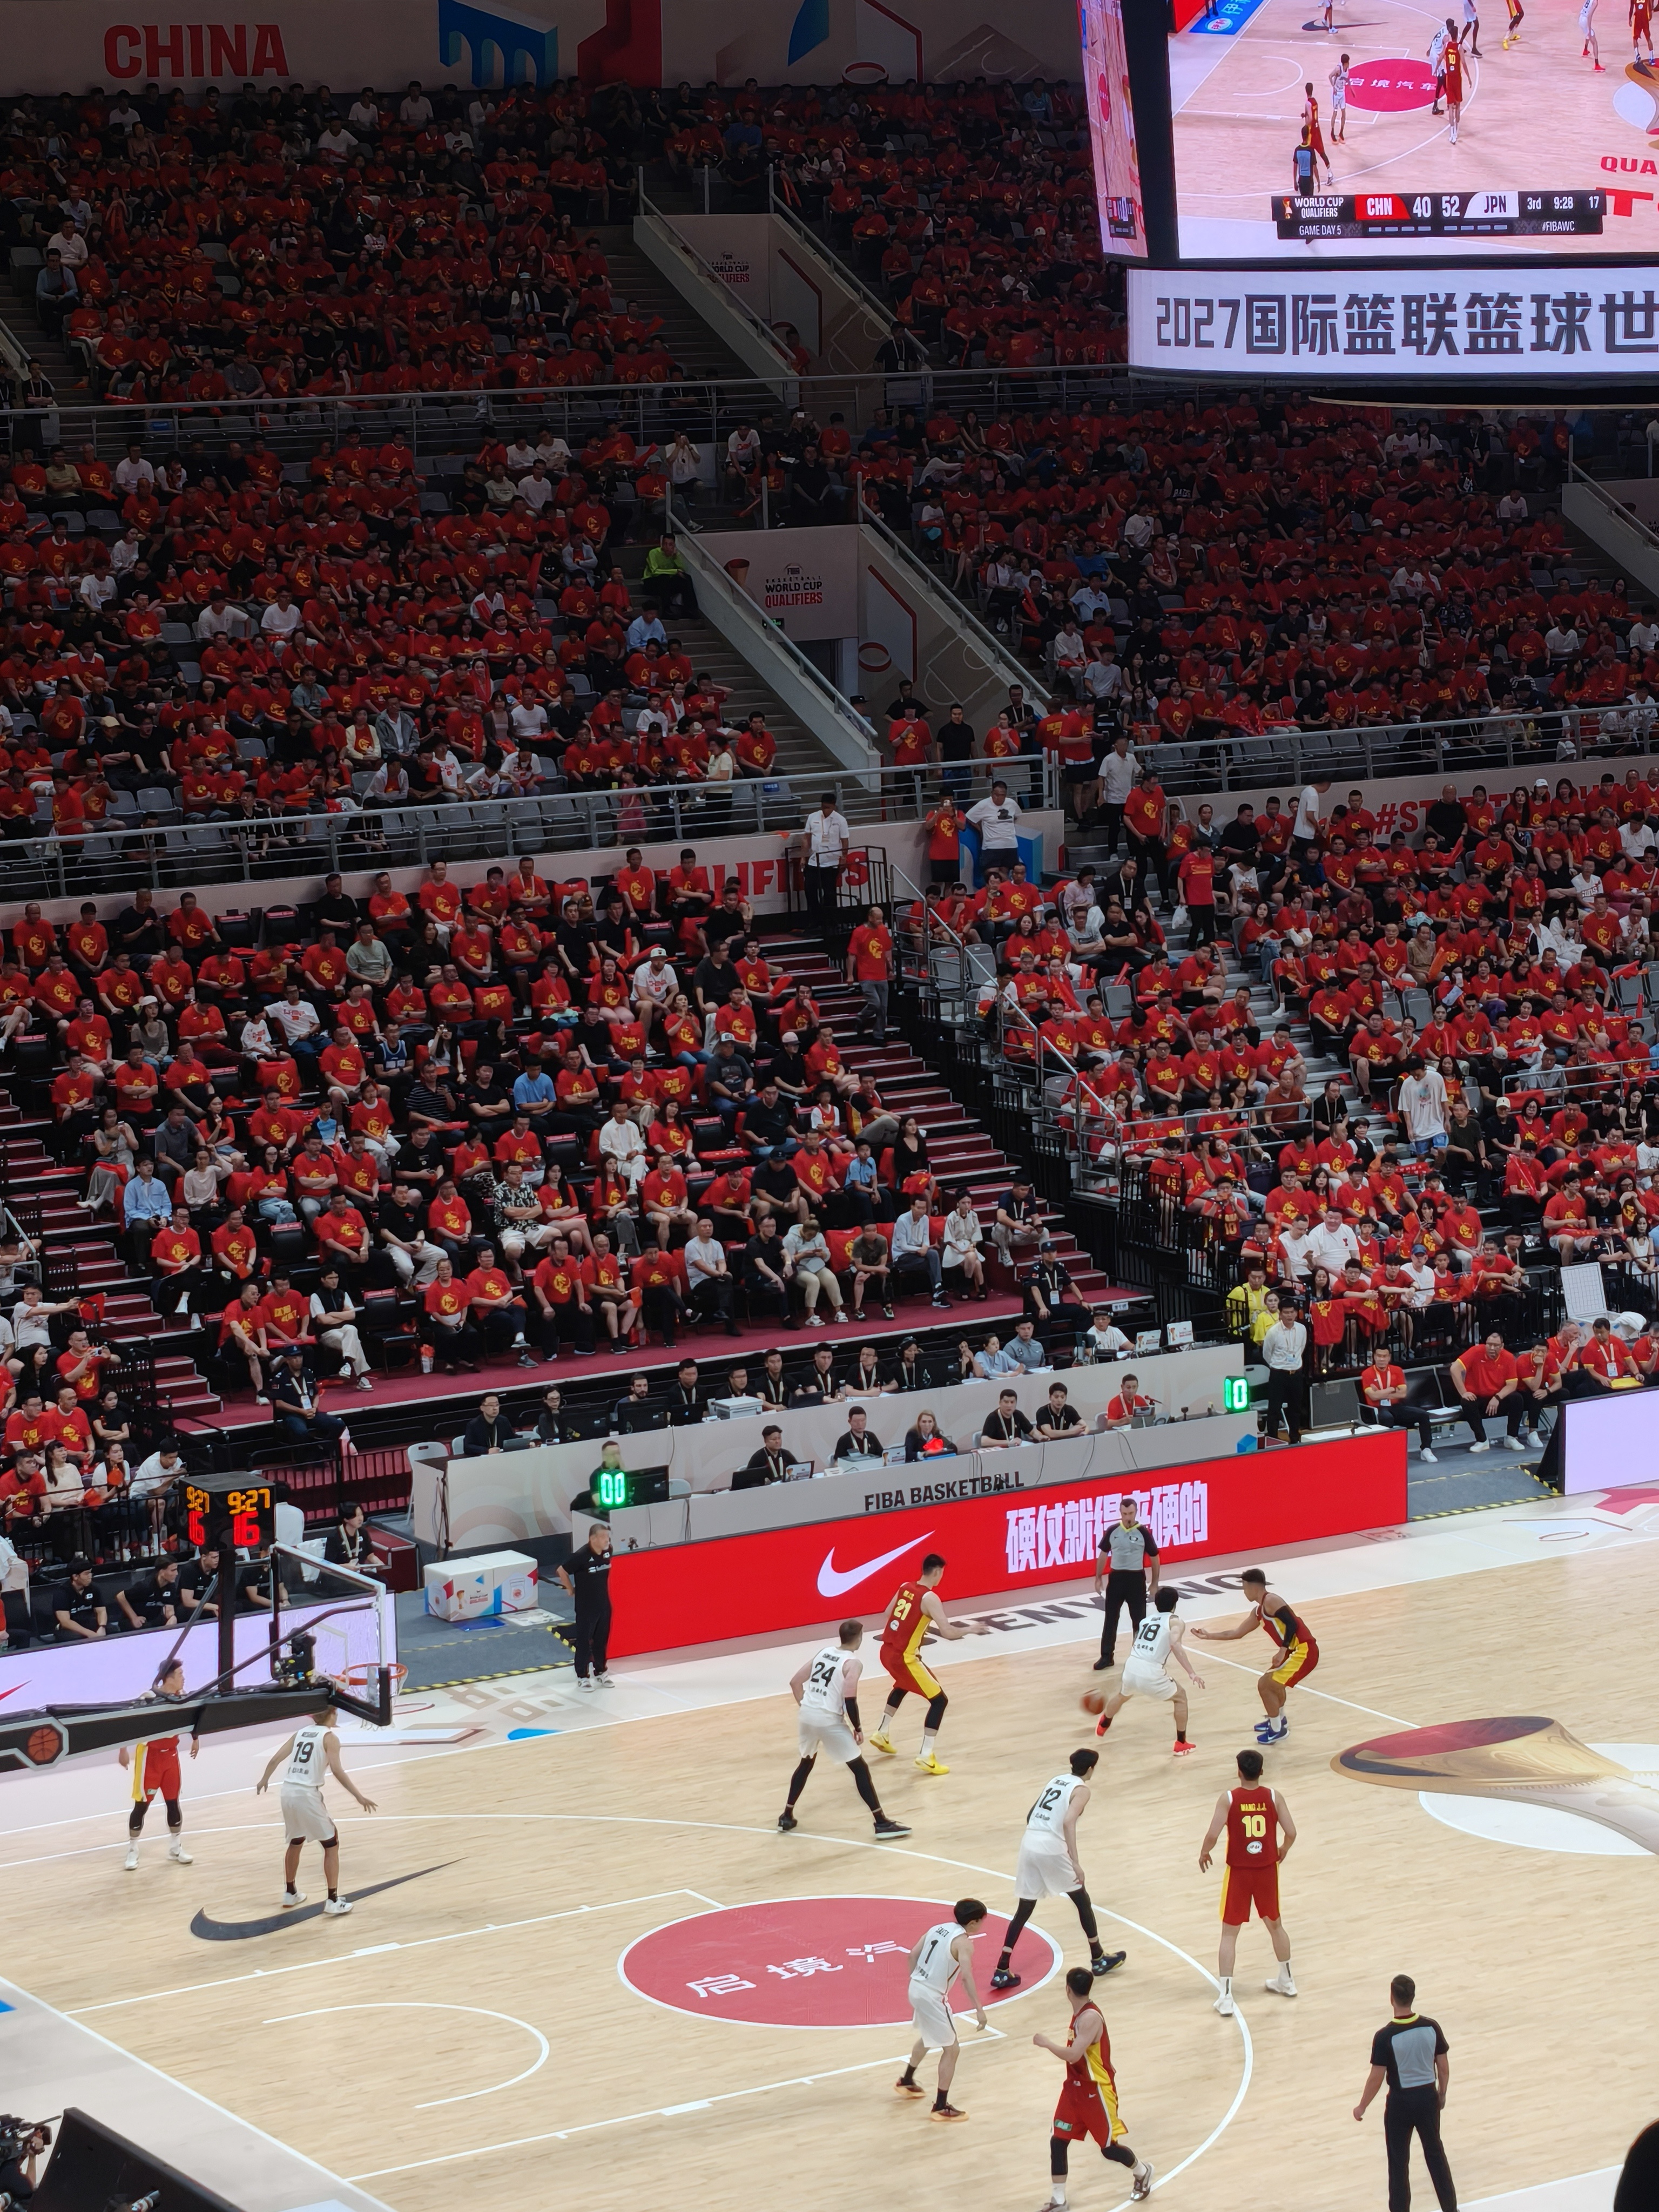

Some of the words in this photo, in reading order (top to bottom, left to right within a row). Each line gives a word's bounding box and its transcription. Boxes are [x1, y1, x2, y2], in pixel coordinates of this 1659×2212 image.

[104, 24, 289, 79] CHINA
[1448, 54, 1456, 64] 10
[1601, 156, 1658, 175] QUA
[1294, 198, 1325, 207] WORLD
[1327, 197, 1344, 206] CUP
[1301, 207, 1338, 218] QUALIFIERS
[1366, 197, 1393, 215] CHN
[1413, 197, 1431, 218] 40
[1442, 195, 1460, 217] 52
[1484, 195, 1507, 213] JPN
[1527, 197, 1542, 210] 3rd
[1553, 197, 1574, 209] 9:28
[1589, 196, 1600, 208] 17
[1299, 225, 1320, 235] GAME
[1321, 225, 1336, 235] DAY
[1337, 225, 1341, 235] 5
[1542, 220, 1575, 232] #FIBAWC
[765, 583, 800, 593] WORLD
[804, 581, 822, 591] CUP
[765, 592, 822, 608] QUALIFIERS
[227, 1488, 270, 1515] 9:27
[864, 1489, 905, 1511] FIBA
[911, 1471, 1024, 1504] BASKETBALL
[234, 1510, 260, 1547] 16
[894, 1599, 912, 1621] 21
[1138, 1623, 1161, 1642] 18
[811, 1662, 836, 1688] 24
[293, 1741, 314, 1763] 19
[1038, 1788, 1062, 1811] 12
[1242, 1815, 1266, 1837] 10
[925, 1939, 939, 1964] 1
[686, 1933, 988, 1998] 启境汽
